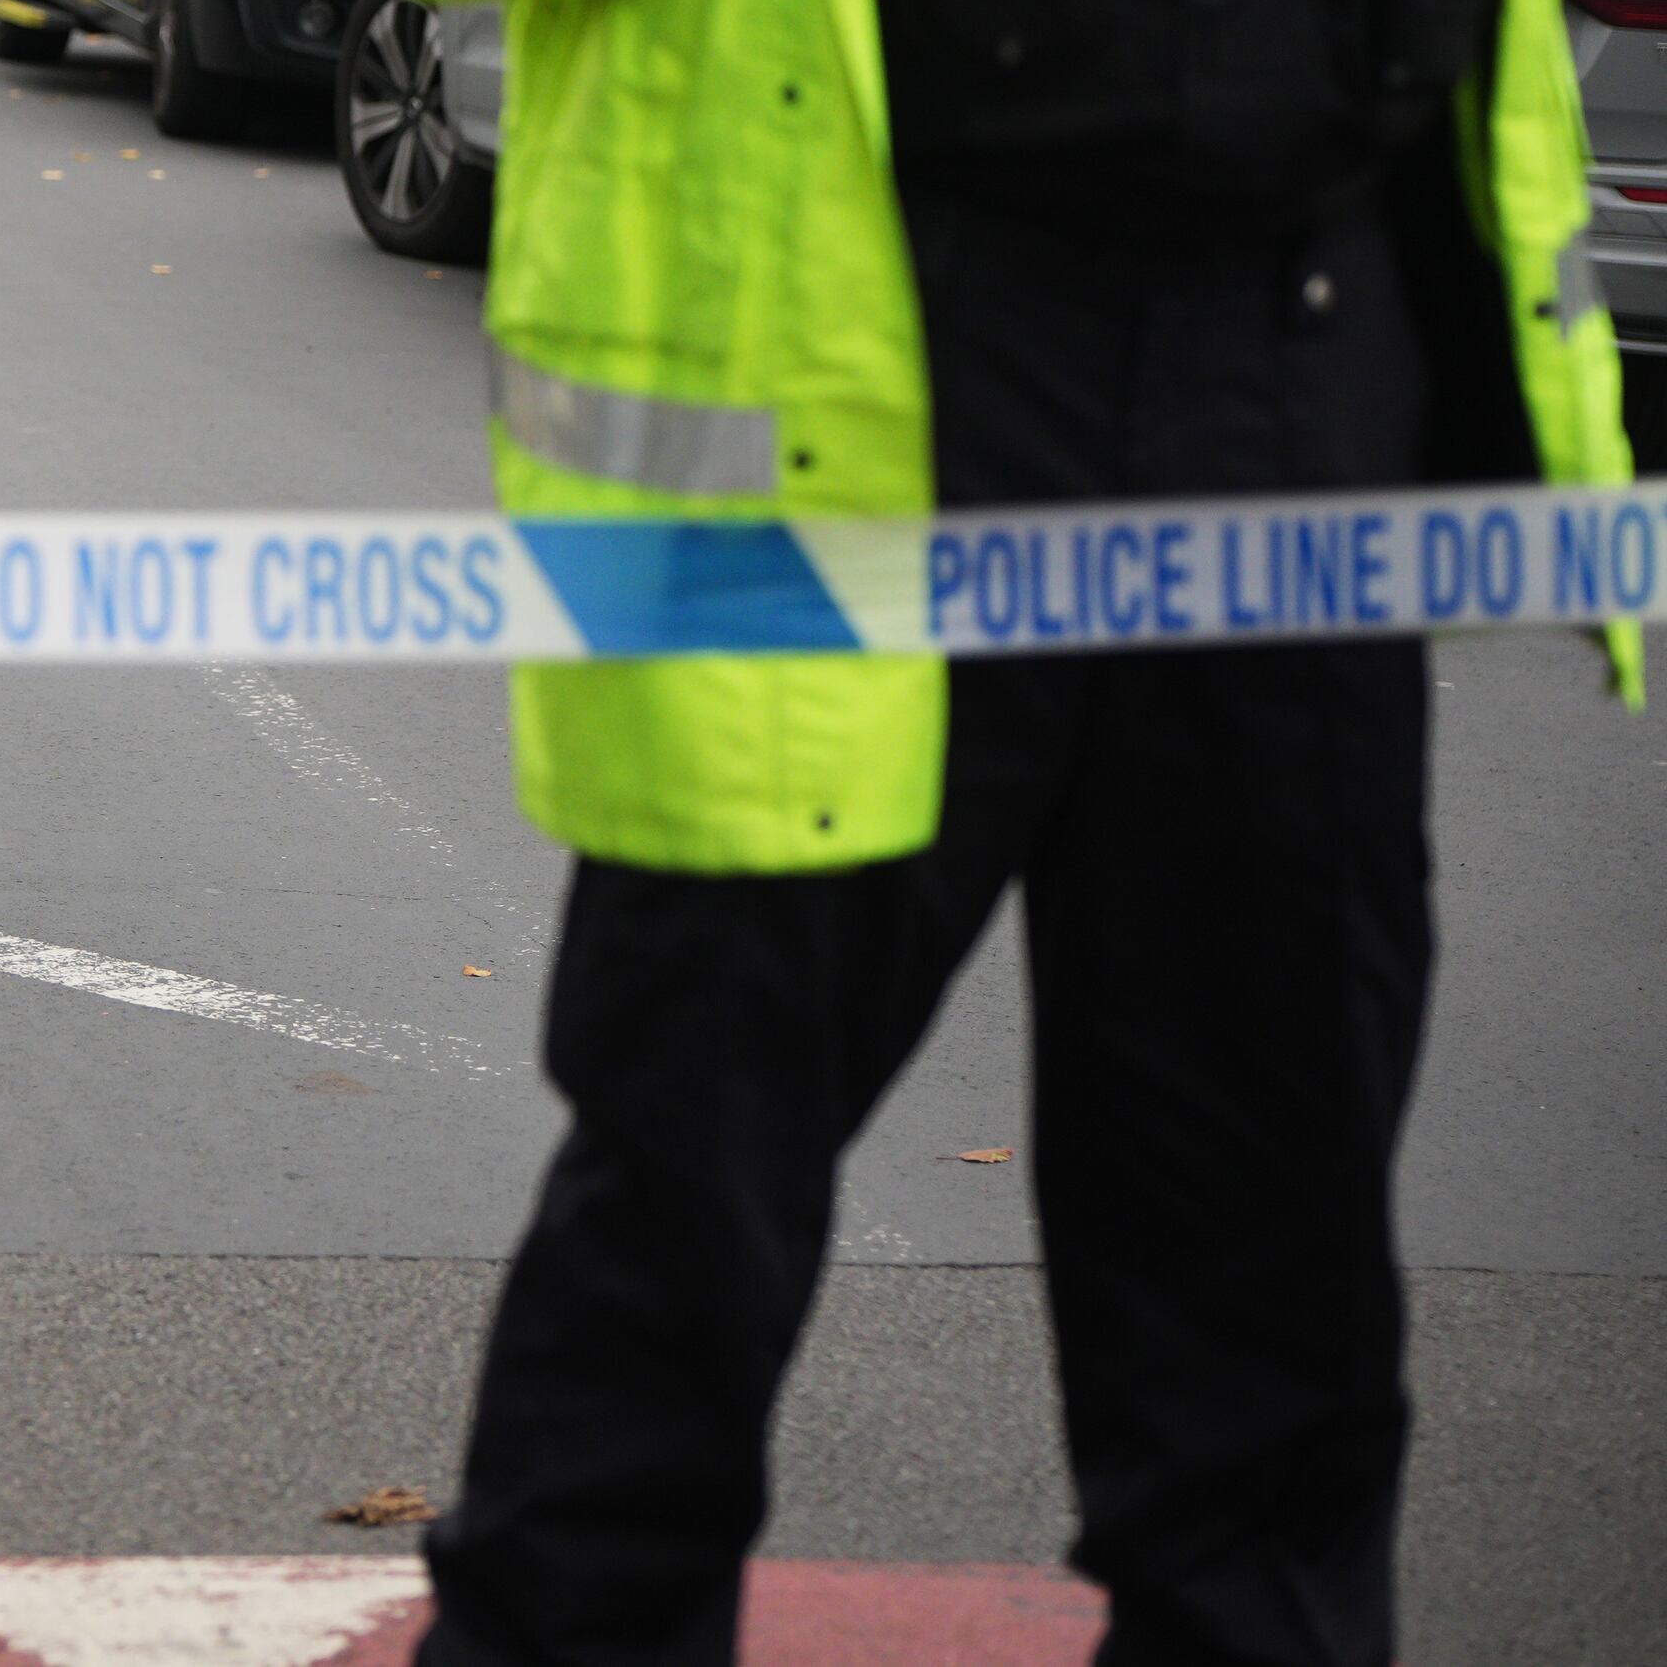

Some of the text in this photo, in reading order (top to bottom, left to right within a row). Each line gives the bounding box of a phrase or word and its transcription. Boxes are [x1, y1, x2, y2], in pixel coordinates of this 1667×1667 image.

[76, 539, 219, 643] NOT
[252, 536, 505, 643] CROSS
[929, 501, 1667, 638] POLICE LINE DO NO
